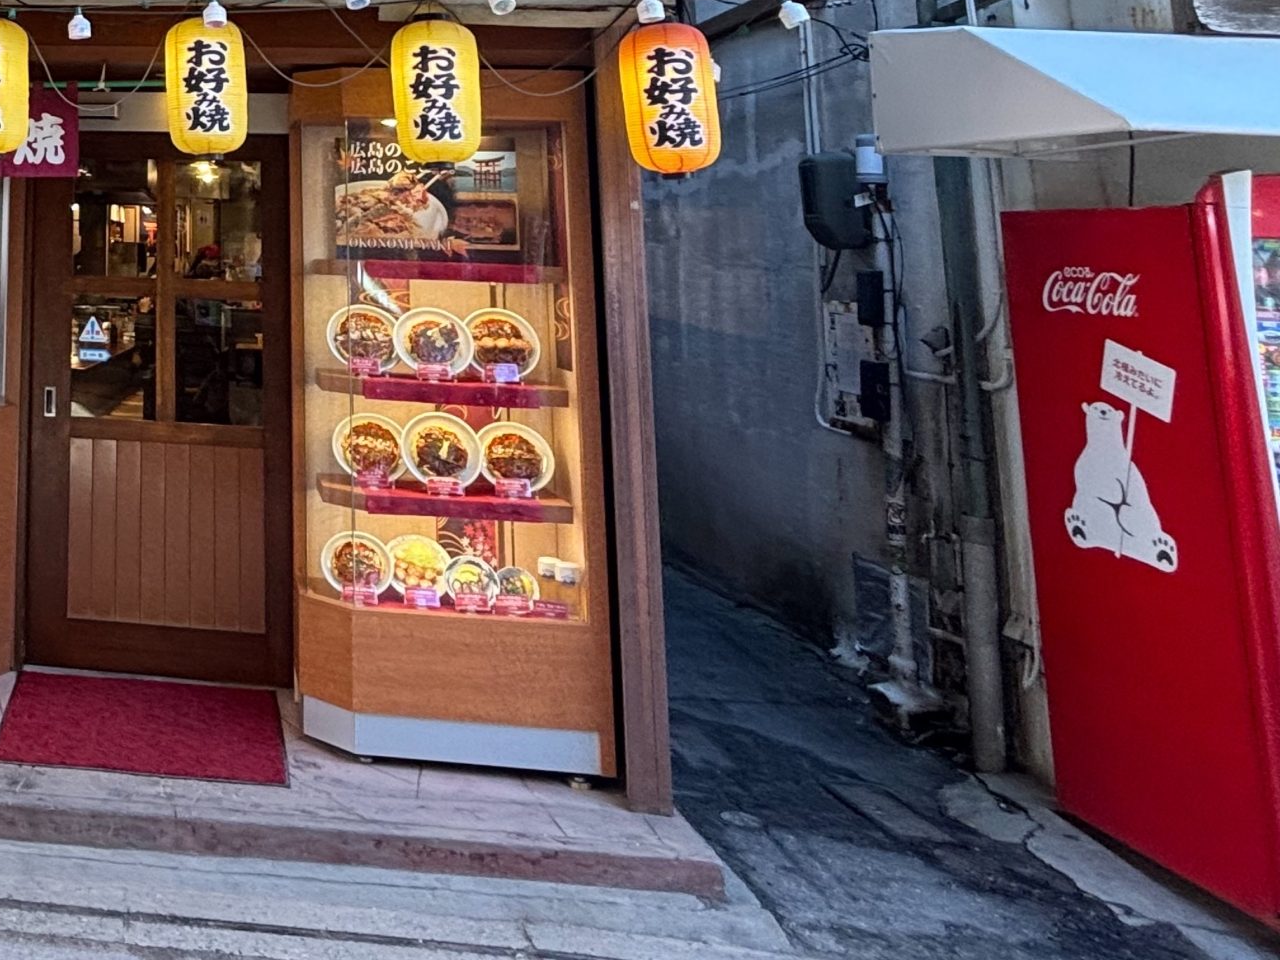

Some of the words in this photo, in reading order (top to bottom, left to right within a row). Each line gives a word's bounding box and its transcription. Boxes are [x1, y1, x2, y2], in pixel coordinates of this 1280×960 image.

[182, 39, 230, 133] お好み焼
[409, 45, 462, 142] お好み焼
[643, 47, 704, 148] お好み焼
[1042, 270, 1141, 318] Coca-Cola
